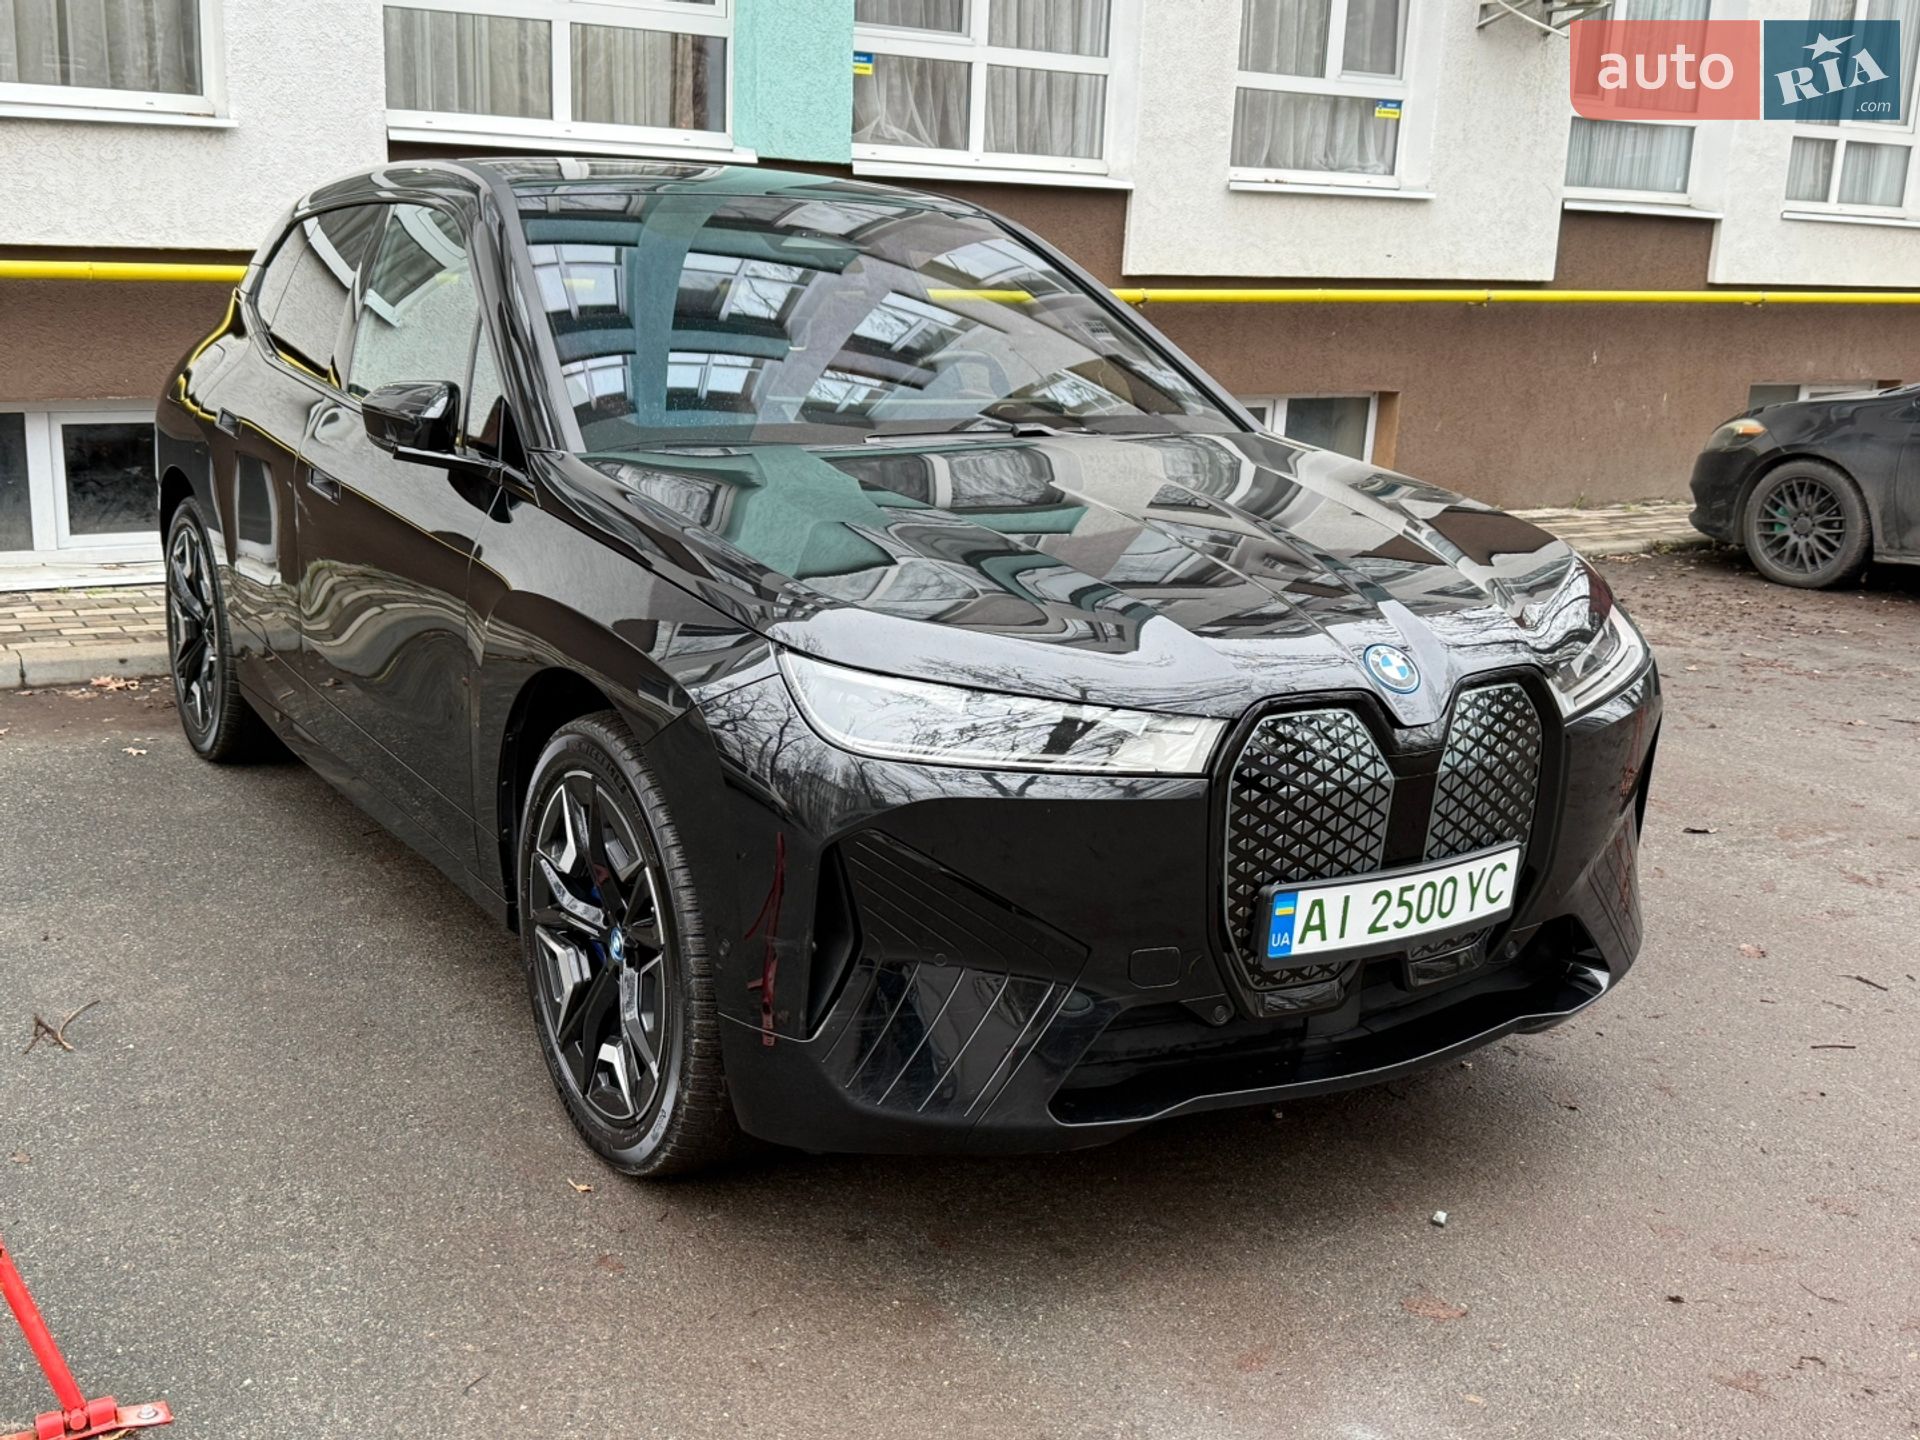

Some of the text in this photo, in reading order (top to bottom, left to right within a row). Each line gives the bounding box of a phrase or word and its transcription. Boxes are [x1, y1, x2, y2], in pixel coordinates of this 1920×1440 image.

[1298, 862, 1508, 944] AI 2500 YC
[1271, 932, 1291, 947] UA
